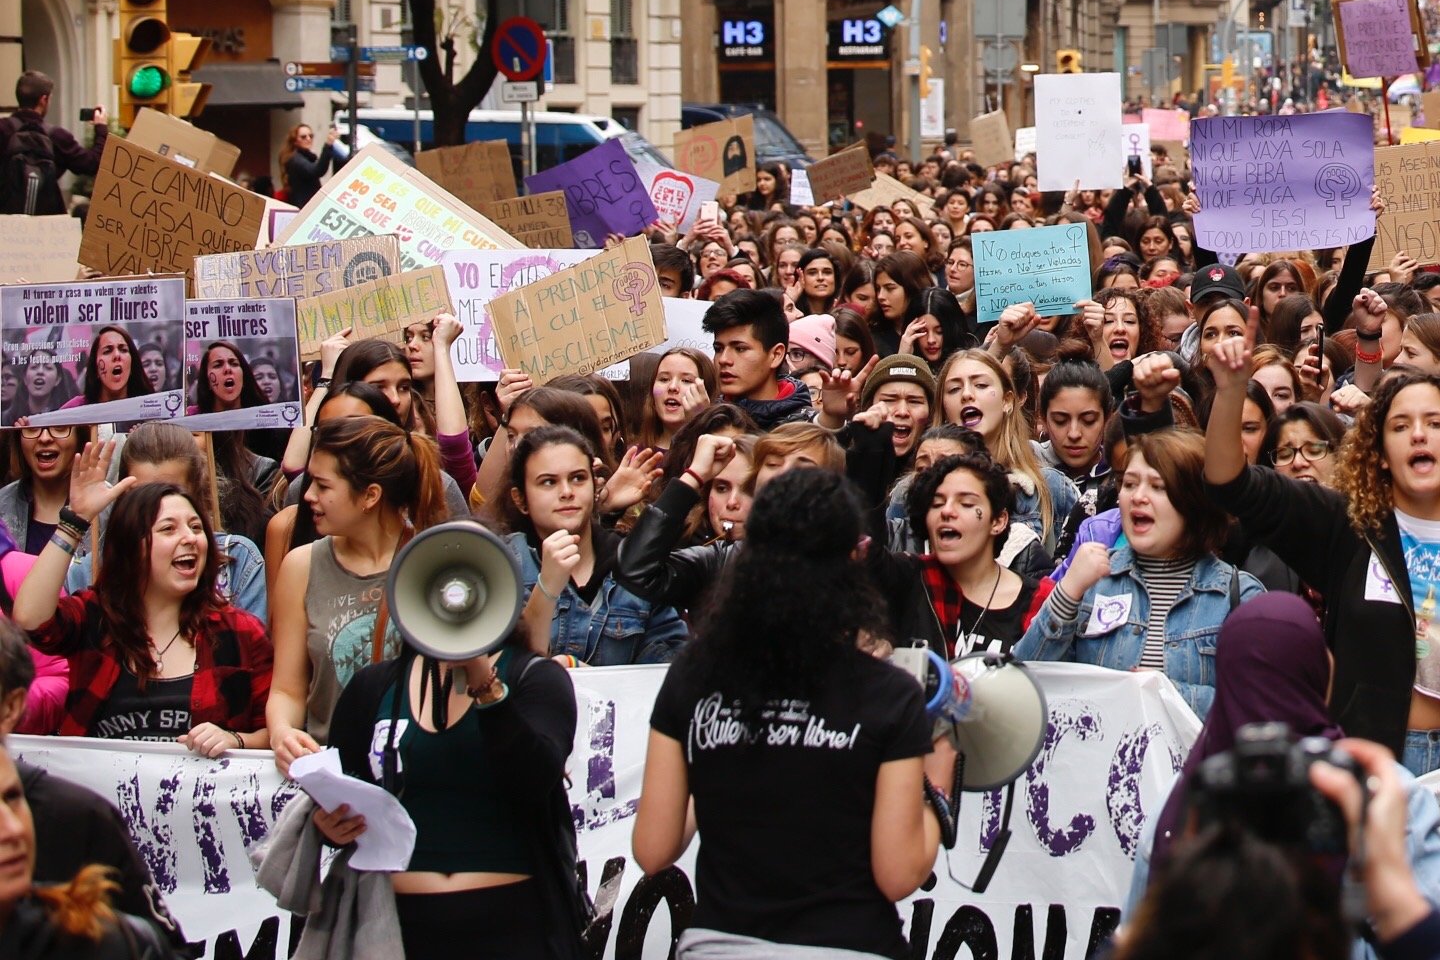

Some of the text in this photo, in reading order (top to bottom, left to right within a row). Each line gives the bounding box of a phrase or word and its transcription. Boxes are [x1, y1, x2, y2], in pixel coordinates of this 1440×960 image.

[724, 21, 764, 44] H3
[843, 19, 882, 43] H3
[1194, 118, 1294, 140] NI MI ROPA
[1191, 140, 1344, 163] NI QUE VAYA SOLA
[112, 146, 155, 187] DE
[1194, 162, 1286, 186] NI QUE BEBA
[348, 179, 370, 196] NO
[373, 193, 398, 213] SEA
[360, 166, 385, 185] NO
[414, 196, 442, 220] QUE
[1197, 187, 1296, 209] NI QUE SALGA
[104, 182, 194, 241] A CASA
[336, 192, 392, 228] ES QUE
[1251, 209, 1306, 227] SI ES SI
[96, 215, 125, 238] SER
[1203, 225, 1367, 249] TODO LO ES NO
[1050, 241, 1065, 254] tus
[254, 243, 342, 277] VOLEM
[454, 262, 480, 289] YO
[33, 289, 56, 298] tornar
[66, 289, 82, 297] casa
[84, 289, 92, 297] no
[95, 286, 114, 297] volem
[117, 286, 128, 295] ser
[130, 285, 158, 294] valentes
[514, 256, 623, 321] A PRENDRE
[979, 283, 1024, 296] Enseña
[23, 297, 158, 325] volem ser lliures
[190, 303, 266, 315] no volem ser valentes
[186, 315, 268, 338] ser lliures
[511, 295, 616, 353] PEL CUL EL
[767, 715, 861, 749] ser libre!
